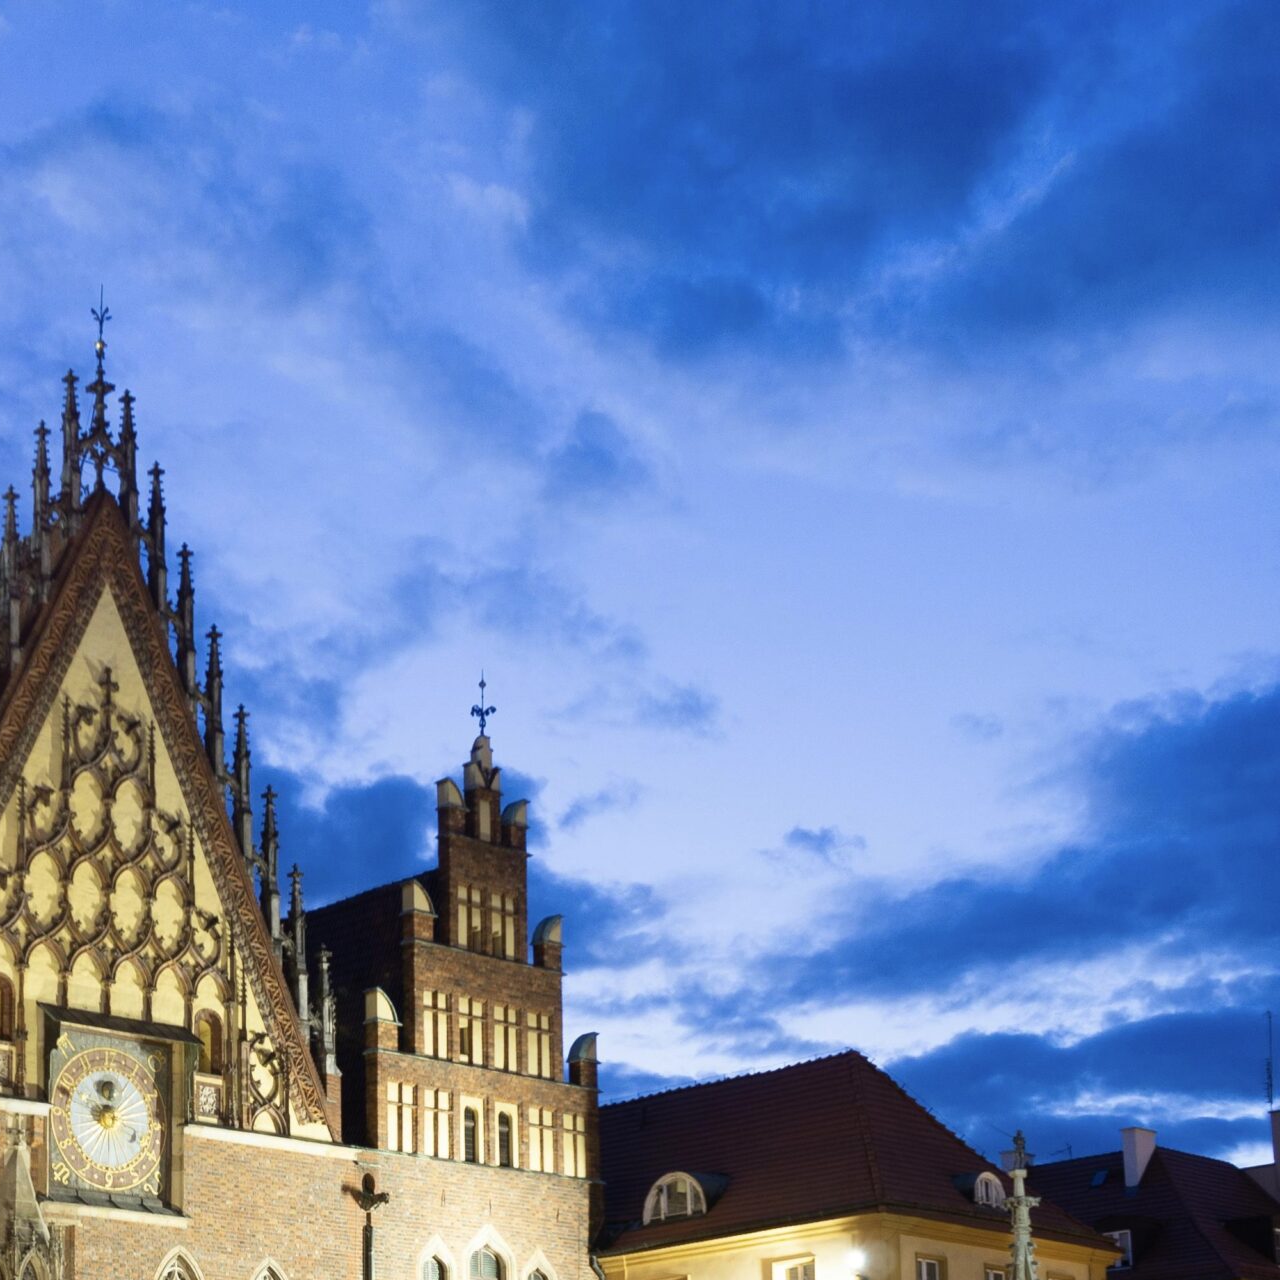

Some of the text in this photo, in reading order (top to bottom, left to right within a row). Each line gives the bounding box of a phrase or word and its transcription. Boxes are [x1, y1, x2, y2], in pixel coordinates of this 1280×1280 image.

[60, 1072, 75, 1090] 10
[59, 1138, 72, 1149] 8
[146, 1150, 158, 1162] 4
[104, 1171, 113, 1187] 6
[129, 1167, 140, 1184] 5
